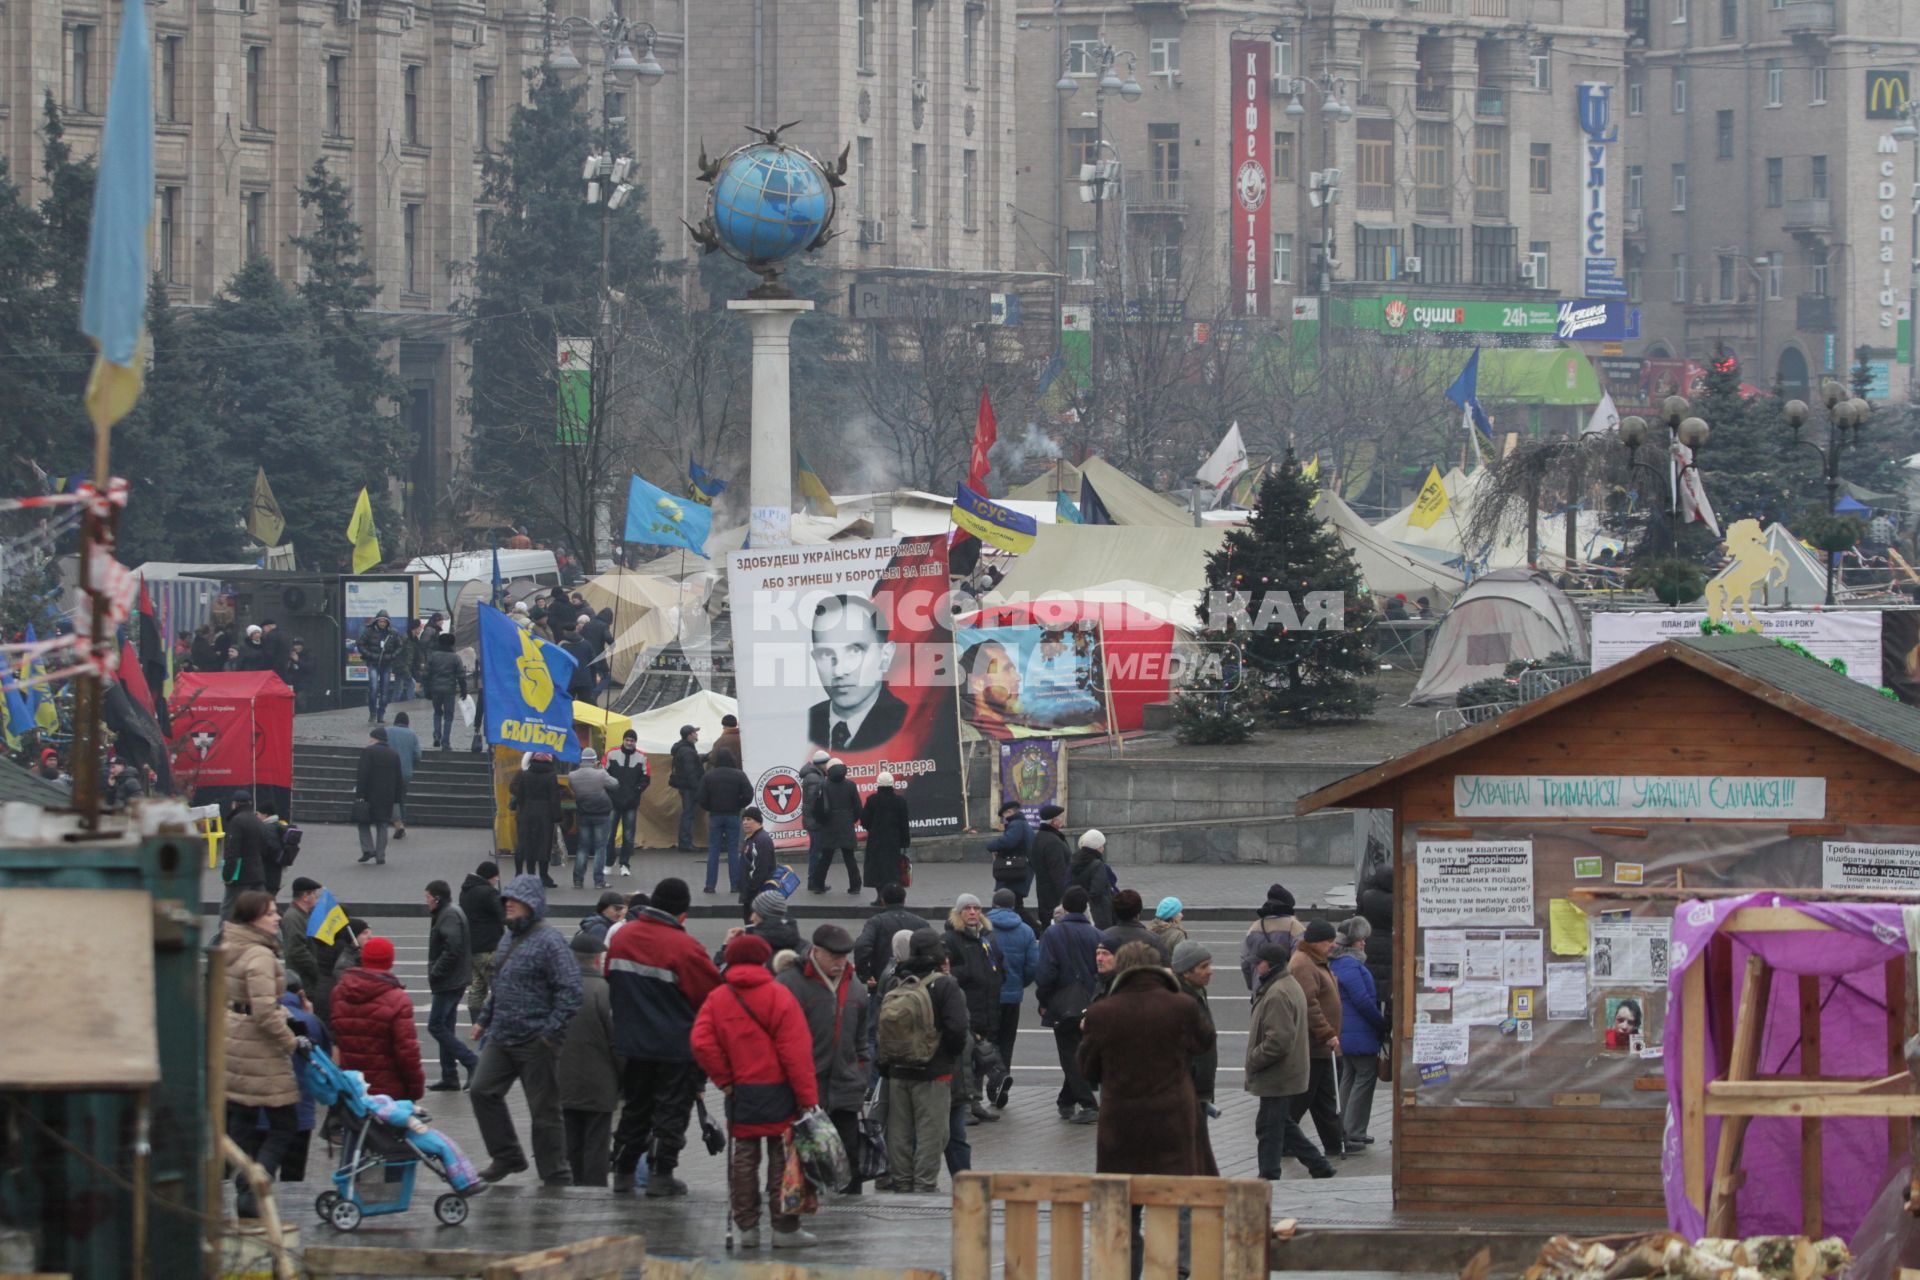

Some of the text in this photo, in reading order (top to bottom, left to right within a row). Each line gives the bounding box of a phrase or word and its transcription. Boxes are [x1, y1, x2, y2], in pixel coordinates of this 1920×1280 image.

[1503, 308, 1527, 327] 24h
[737, 542, 933, 571] ЗДОБУДЕШ УКРАЇНСЬКУ ДЕРЖАВУ,
[762, 561, 943, 589] АБО ЗГИНЕШ У БОРОТЬБІ ЗА НЕЇ!
[1662, 620, 1681, 629] ПЛАН
[1683, 619, 1696, 629] ДІЙ
[1775, 620, 1793, 628] 2014
[1795, 620, 1815, 629] РОКУ
[846, 758, 936, 778] епан Бандера
[769, 829, 808, 840] ОНГРЕС
[1425, 846, 1432, 854] А
[1476, 846, 1524, 854] хвалитися
[1827, 845, 1856, 855] Треба
[1422, 857, 1457, 865] гаранту
[1467, 855, 1528, 865] новорічному
[1825, 855, 1866, 864] (відібрати
[1868, 857, 1873, 865] у
[1875, 858, 1898, 867] держ.
[1473, 866, 1511, 875] державі
[1843, 865, 1919, 878] майно крадіїв
[1423, 875, 1527, 885] окрім таємних поїздок
[1420, 886, 1430, 894] до
[1475, 896, 1510, 905] вилизує
[1511, 895, 1529, 904] собі
[1420, 905, 1461, 914] підтримку
[1475, 905, 1506, 914] вибори
[1507, 904, 1532, 913] 2015?
